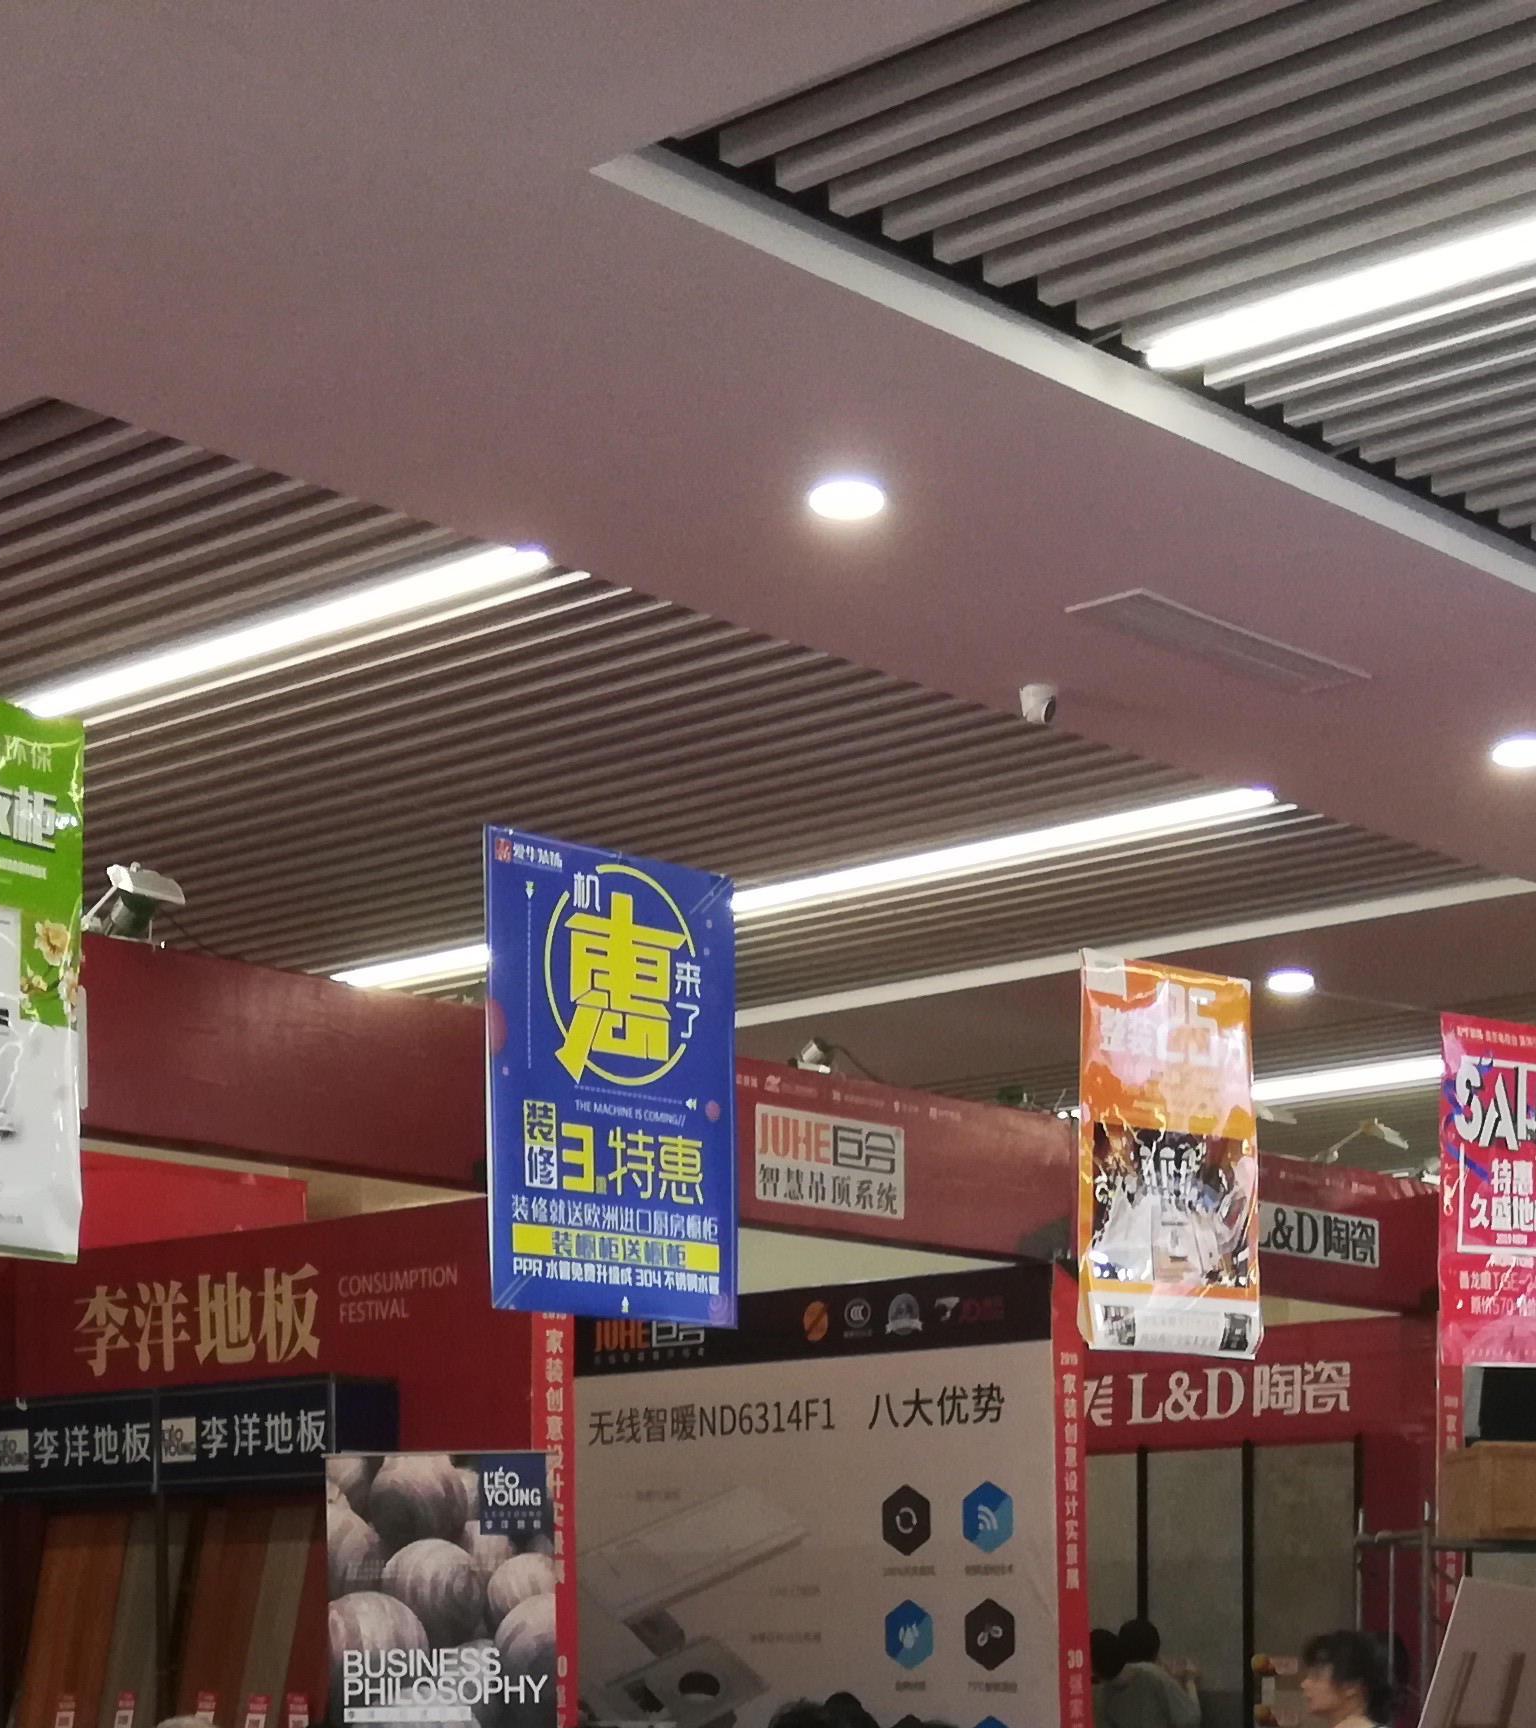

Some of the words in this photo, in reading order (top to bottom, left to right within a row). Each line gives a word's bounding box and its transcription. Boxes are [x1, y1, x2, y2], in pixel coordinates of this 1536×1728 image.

[526, 1102, 556, 1188] 装修
[607, 1126, 705, 1205] 特惠
[759, 1112, 831, 1165] JUHE
[758, 1163, 898, 1215] 智慧吊顶系统
[1322, 1214, 1377, 1265] 陶瓷
[338, 1262, 459, 1299] CONSUMPTION
[513, 1257, 542, 1278] PPR
[635, 1268, 662, 1289] 304
[72, 1262, 322, 1379] 李洋地板
[338, 1298, 410, 1325] FESTIVAL
[587, 1395, 836, 1447] 无线智暖ND6314F1
[868, 1382, 1006, 1432] 八大优势
[1126, 1367, 1246, 1426] L&D
[1252, 1360, 1351, 1418] 陶瓷
[32, 1421, 152, 1470] 李洋地板
[201, 1408, 328, 1459] 李洋地板
[485, 1488, 542, 1507] YOUNG
[342, 1648, 502, 1679] BUSINESS
[343, 1674, 549, 1707] PHILOSOPHY
